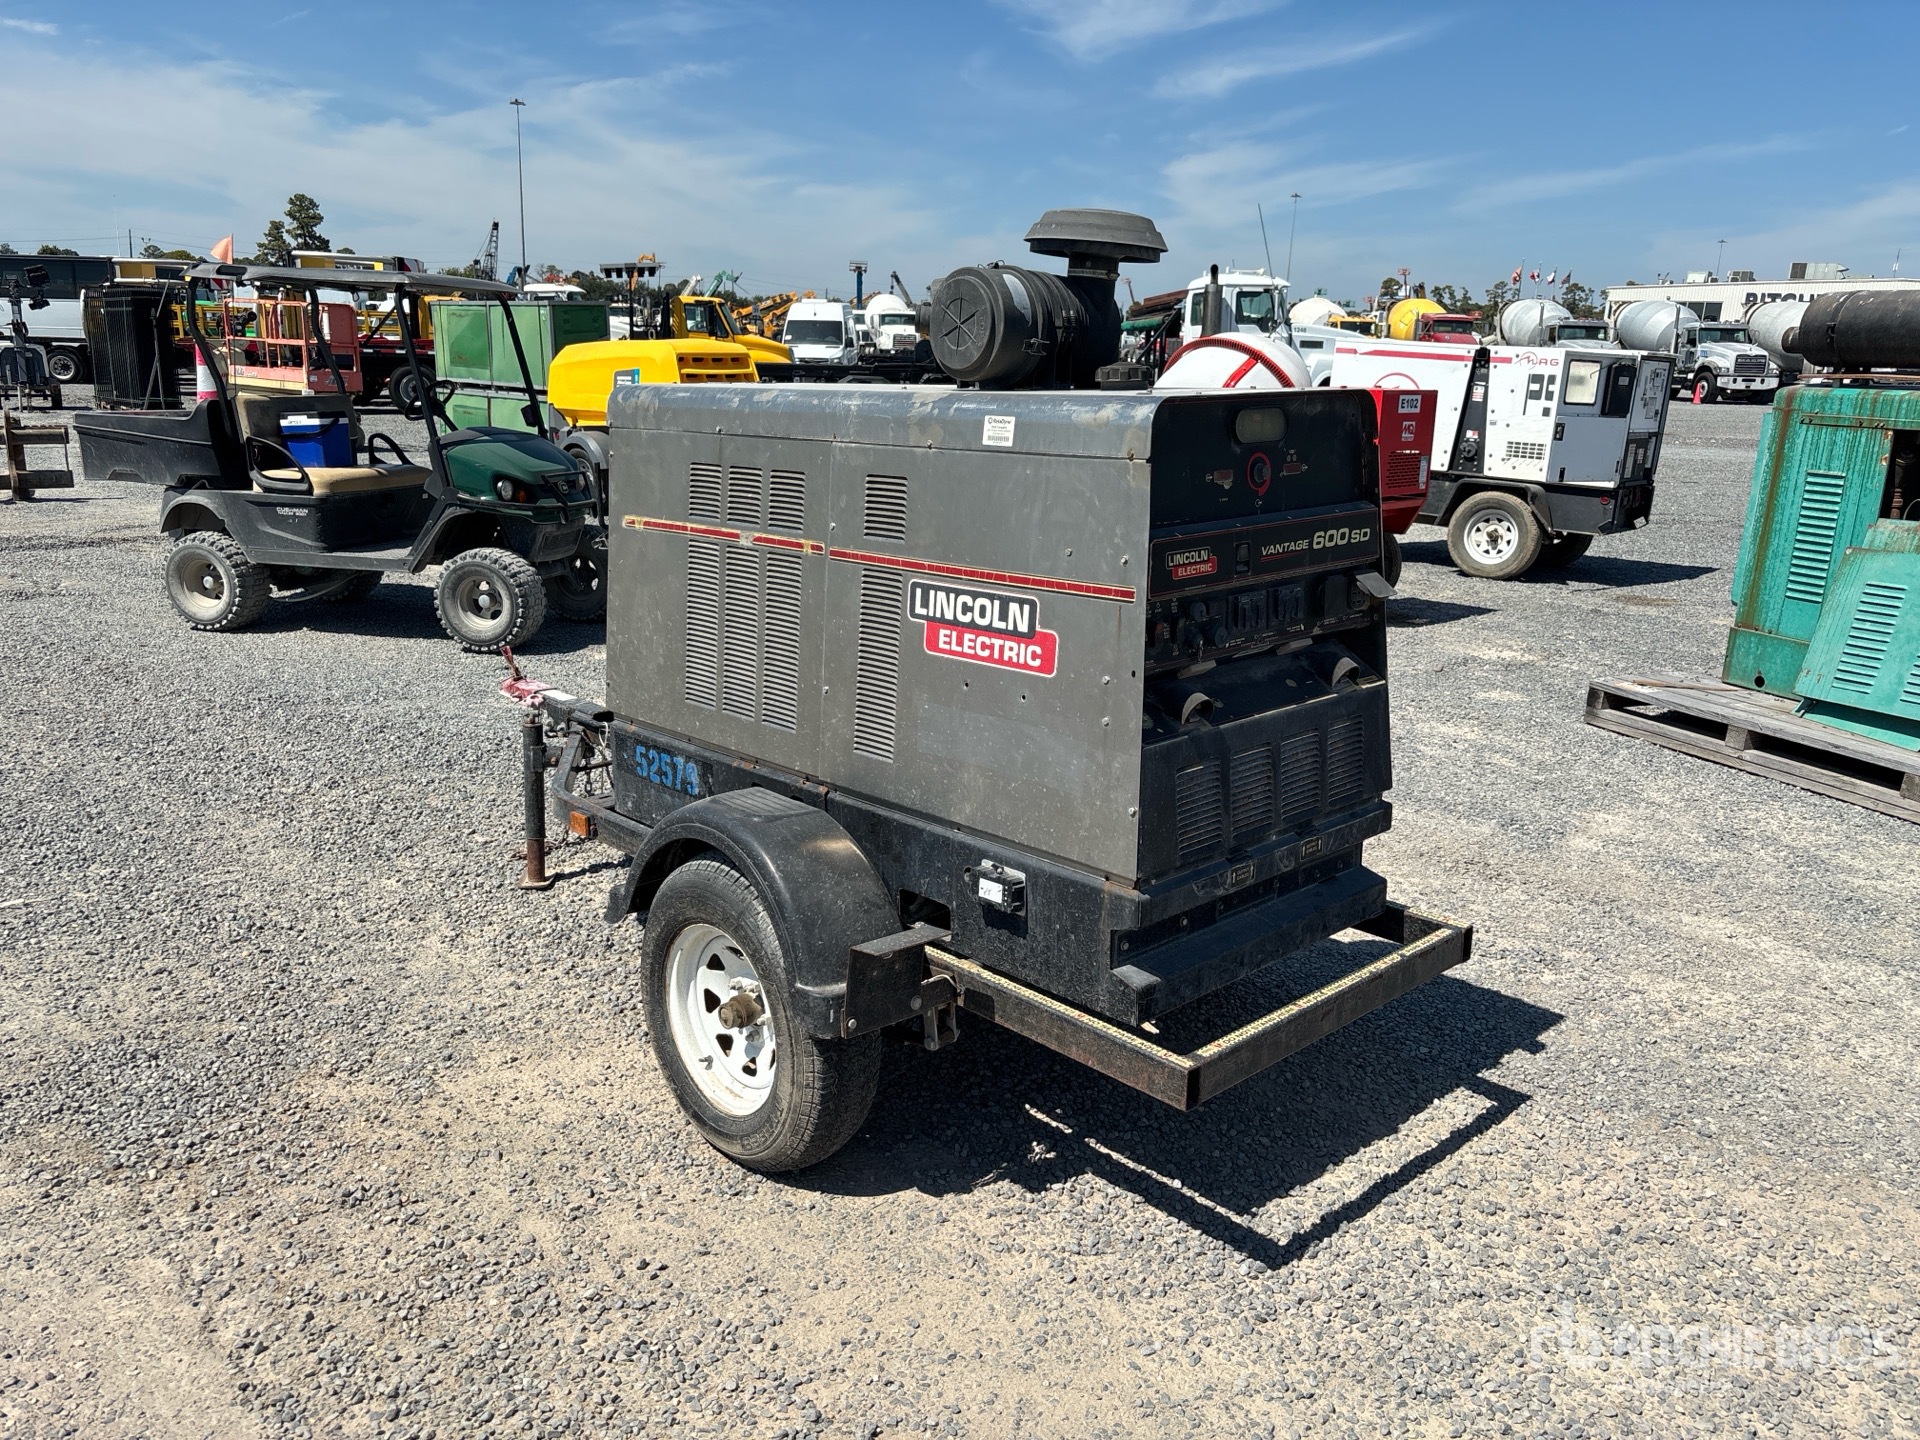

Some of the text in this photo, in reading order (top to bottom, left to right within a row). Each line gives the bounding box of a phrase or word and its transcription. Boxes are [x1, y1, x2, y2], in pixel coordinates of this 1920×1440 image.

[1400, 398, 1419, 410] E102
[1261, 539, 1309, 555] VANTAGE
[1168, 549, 1210, 567] LINCOLN
[1177, 563, 1213, 577] ELECTRIC
[914, 588, 1030, 633] LINCOLN
[938, 629, 1042, 667] ELECTRIC
[635, 745, 699, 796] 52579
